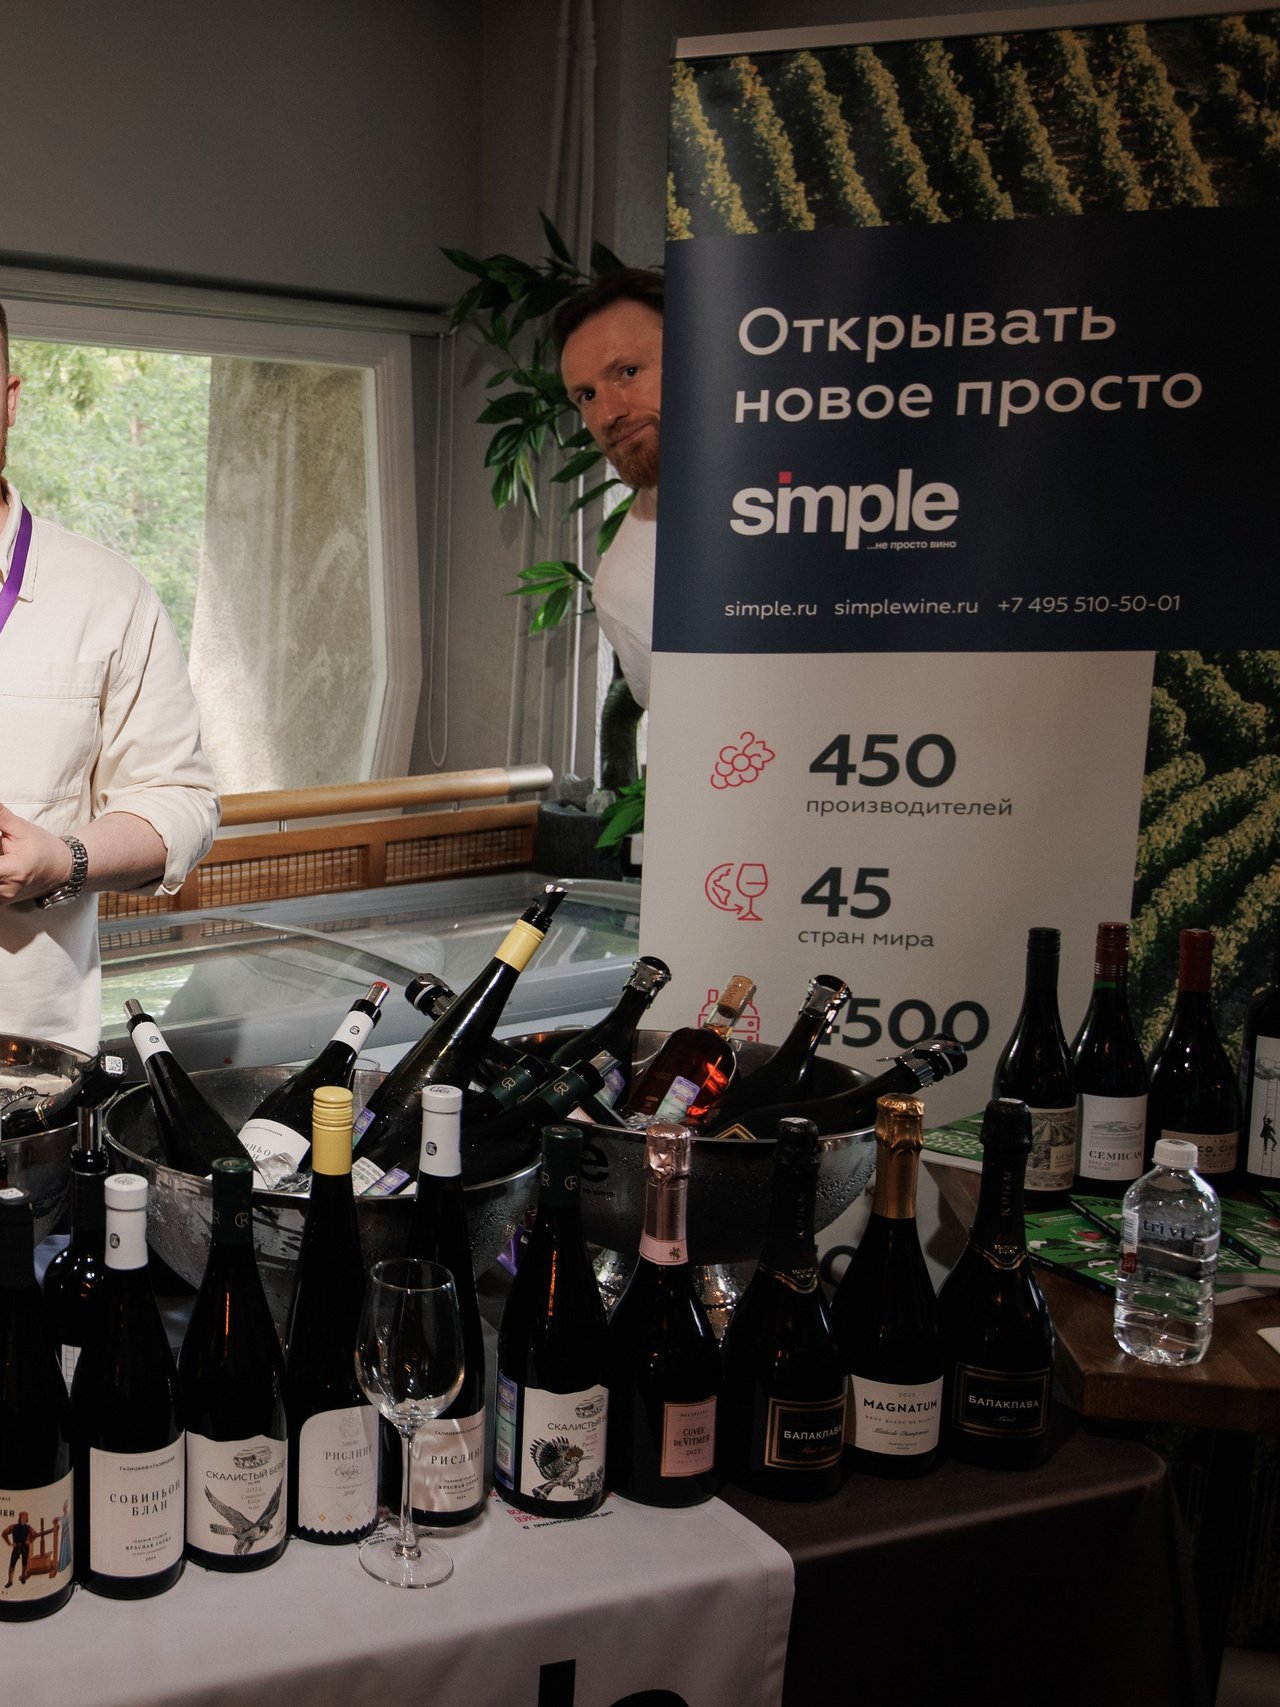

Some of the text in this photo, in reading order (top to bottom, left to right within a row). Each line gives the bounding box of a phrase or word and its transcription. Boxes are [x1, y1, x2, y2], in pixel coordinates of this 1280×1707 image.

[738, 305, 1117, 363] Открывать
[734, 372, 1204, 428] новое просто
[730, 468, 960, 550] simple
[889, 540, 928, 551] просто
[930, 540, 958, 549] вино
[724, 594, 1181, 619] simple.ru simplewine.ru +7 495 510-50-01
[809, 733, 957, 788] 450
[806, 797, 1013, 817] производителей
[801, 867, 892, 920] 45
[797, 929, 935, 951] стран мира
[818, 997, 990, 1052] 500
[1088, 1150, 1143, 1161] СЕМИСАМ
[1001, 1170, 1014, 1216] КРЫМ
[863, 1397, 937, 1413] MAGNATUM
[968, 1394, 1040, 1409] БАЛАКЛАВА
[547, 1416, 602, 1431] СКАЛИСТЫЙ
[783, 1424, 842, 1440] БАЛАКЛАВА
[325, 1443, 373, 1461] РИСЛИНГ
[205, 1469, 268, 1482] СКАЛИСТЫЙ
[109, 1479, 180, 1504] СОВИНЬОН
[132, 1499, 167, 1517] БЛАН
[126, 1543, 154, 1551] КРАСНАЯ
